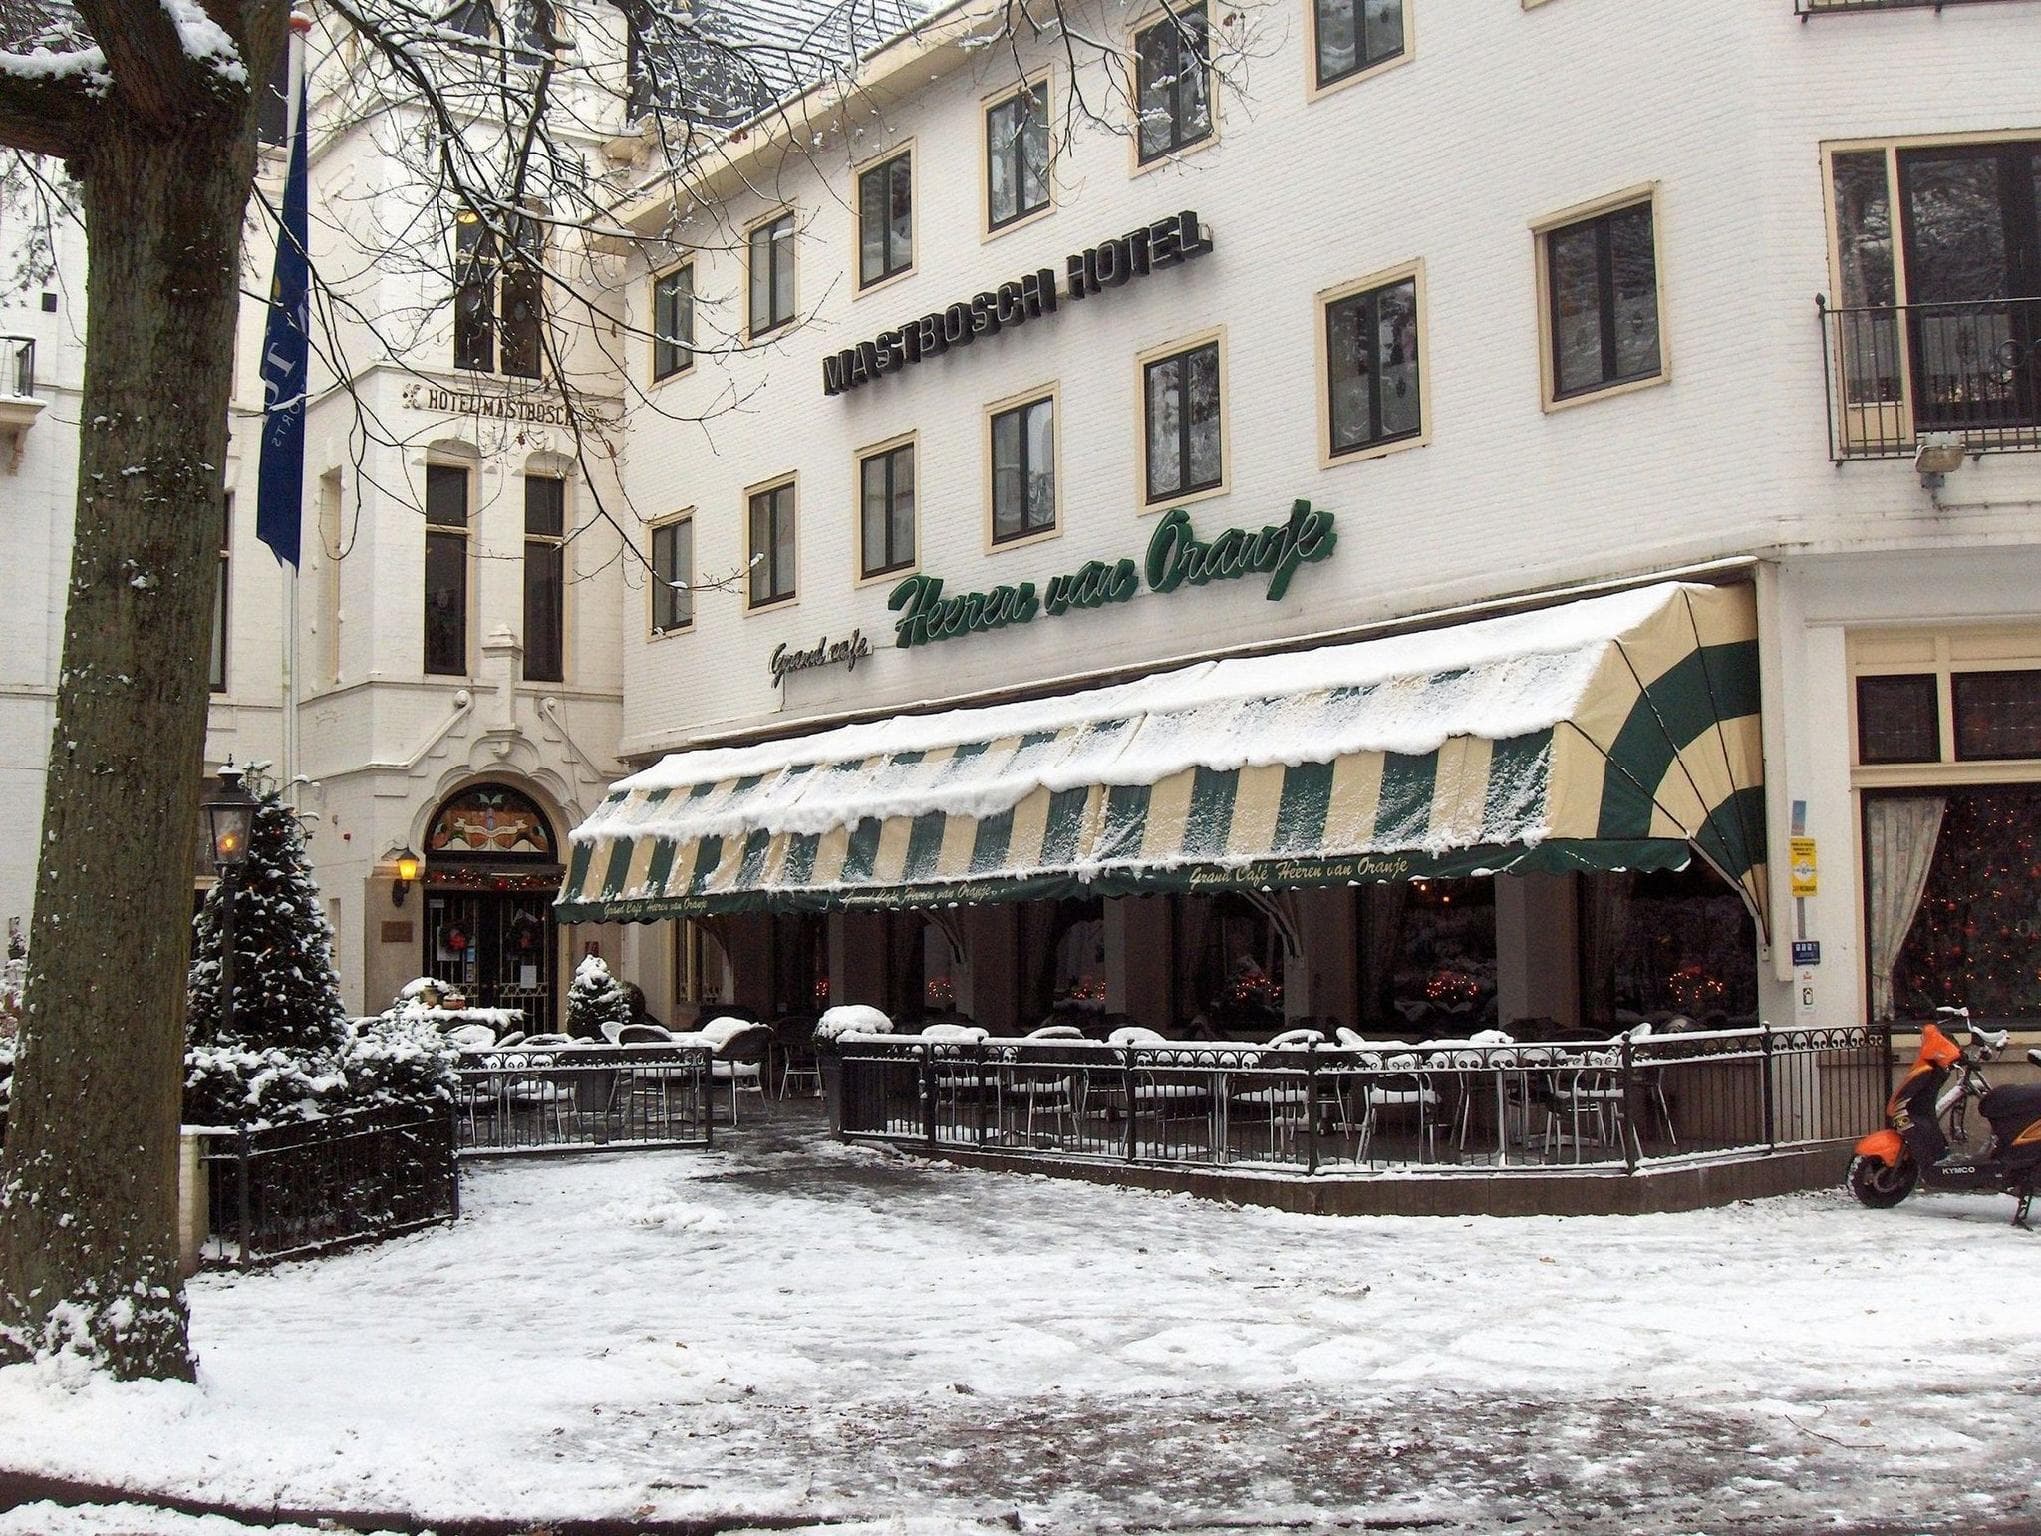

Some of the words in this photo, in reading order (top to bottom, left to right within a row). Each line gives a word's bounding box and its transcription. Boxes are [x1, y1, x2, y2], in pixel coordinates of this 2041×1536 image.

[823, 268, 1056, 396] MASTBOSCH
[1066, 210, 1213, 299] HOTEL
[428, 389, 479, 414] HOTEL
[887, 575, 1039, 648] Heeren
[1044, 558, 1139, 616] van
[1144, 498, 1337, 601] Oranje
[768, 636, 827, 689] Grand
[1188, 867, 1231, 890] Grand
[1236, 864, 1269, 886] Café
[1275, 861, 1323, 880] Heeren
[1327, 863, 1352, 876] van
[1357, 857, 1409, 878] Oranje
[1942, 1166, 1976, 1176] KYMCO
